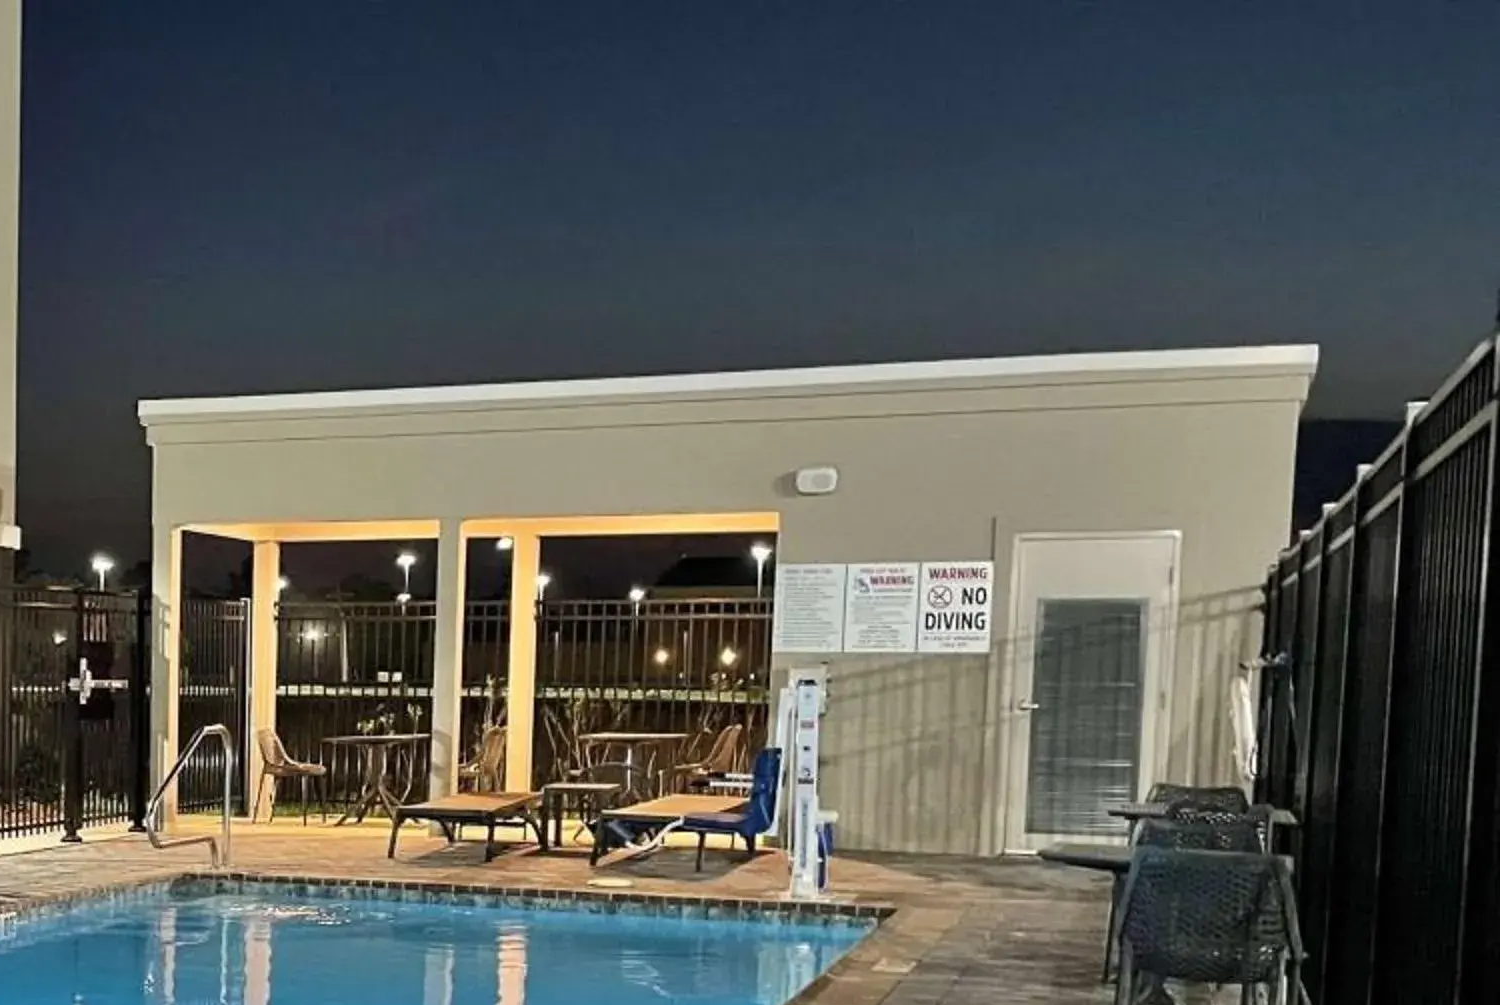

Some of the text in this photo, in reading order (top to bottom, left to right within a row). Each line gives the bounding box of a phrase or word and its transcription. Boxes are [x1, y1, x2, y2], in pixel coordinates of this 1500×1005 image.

[928, 567, 988, 579] WARNING
[961, 587, 987, 605] NO
[925, 611, 986, 630] DIVING
